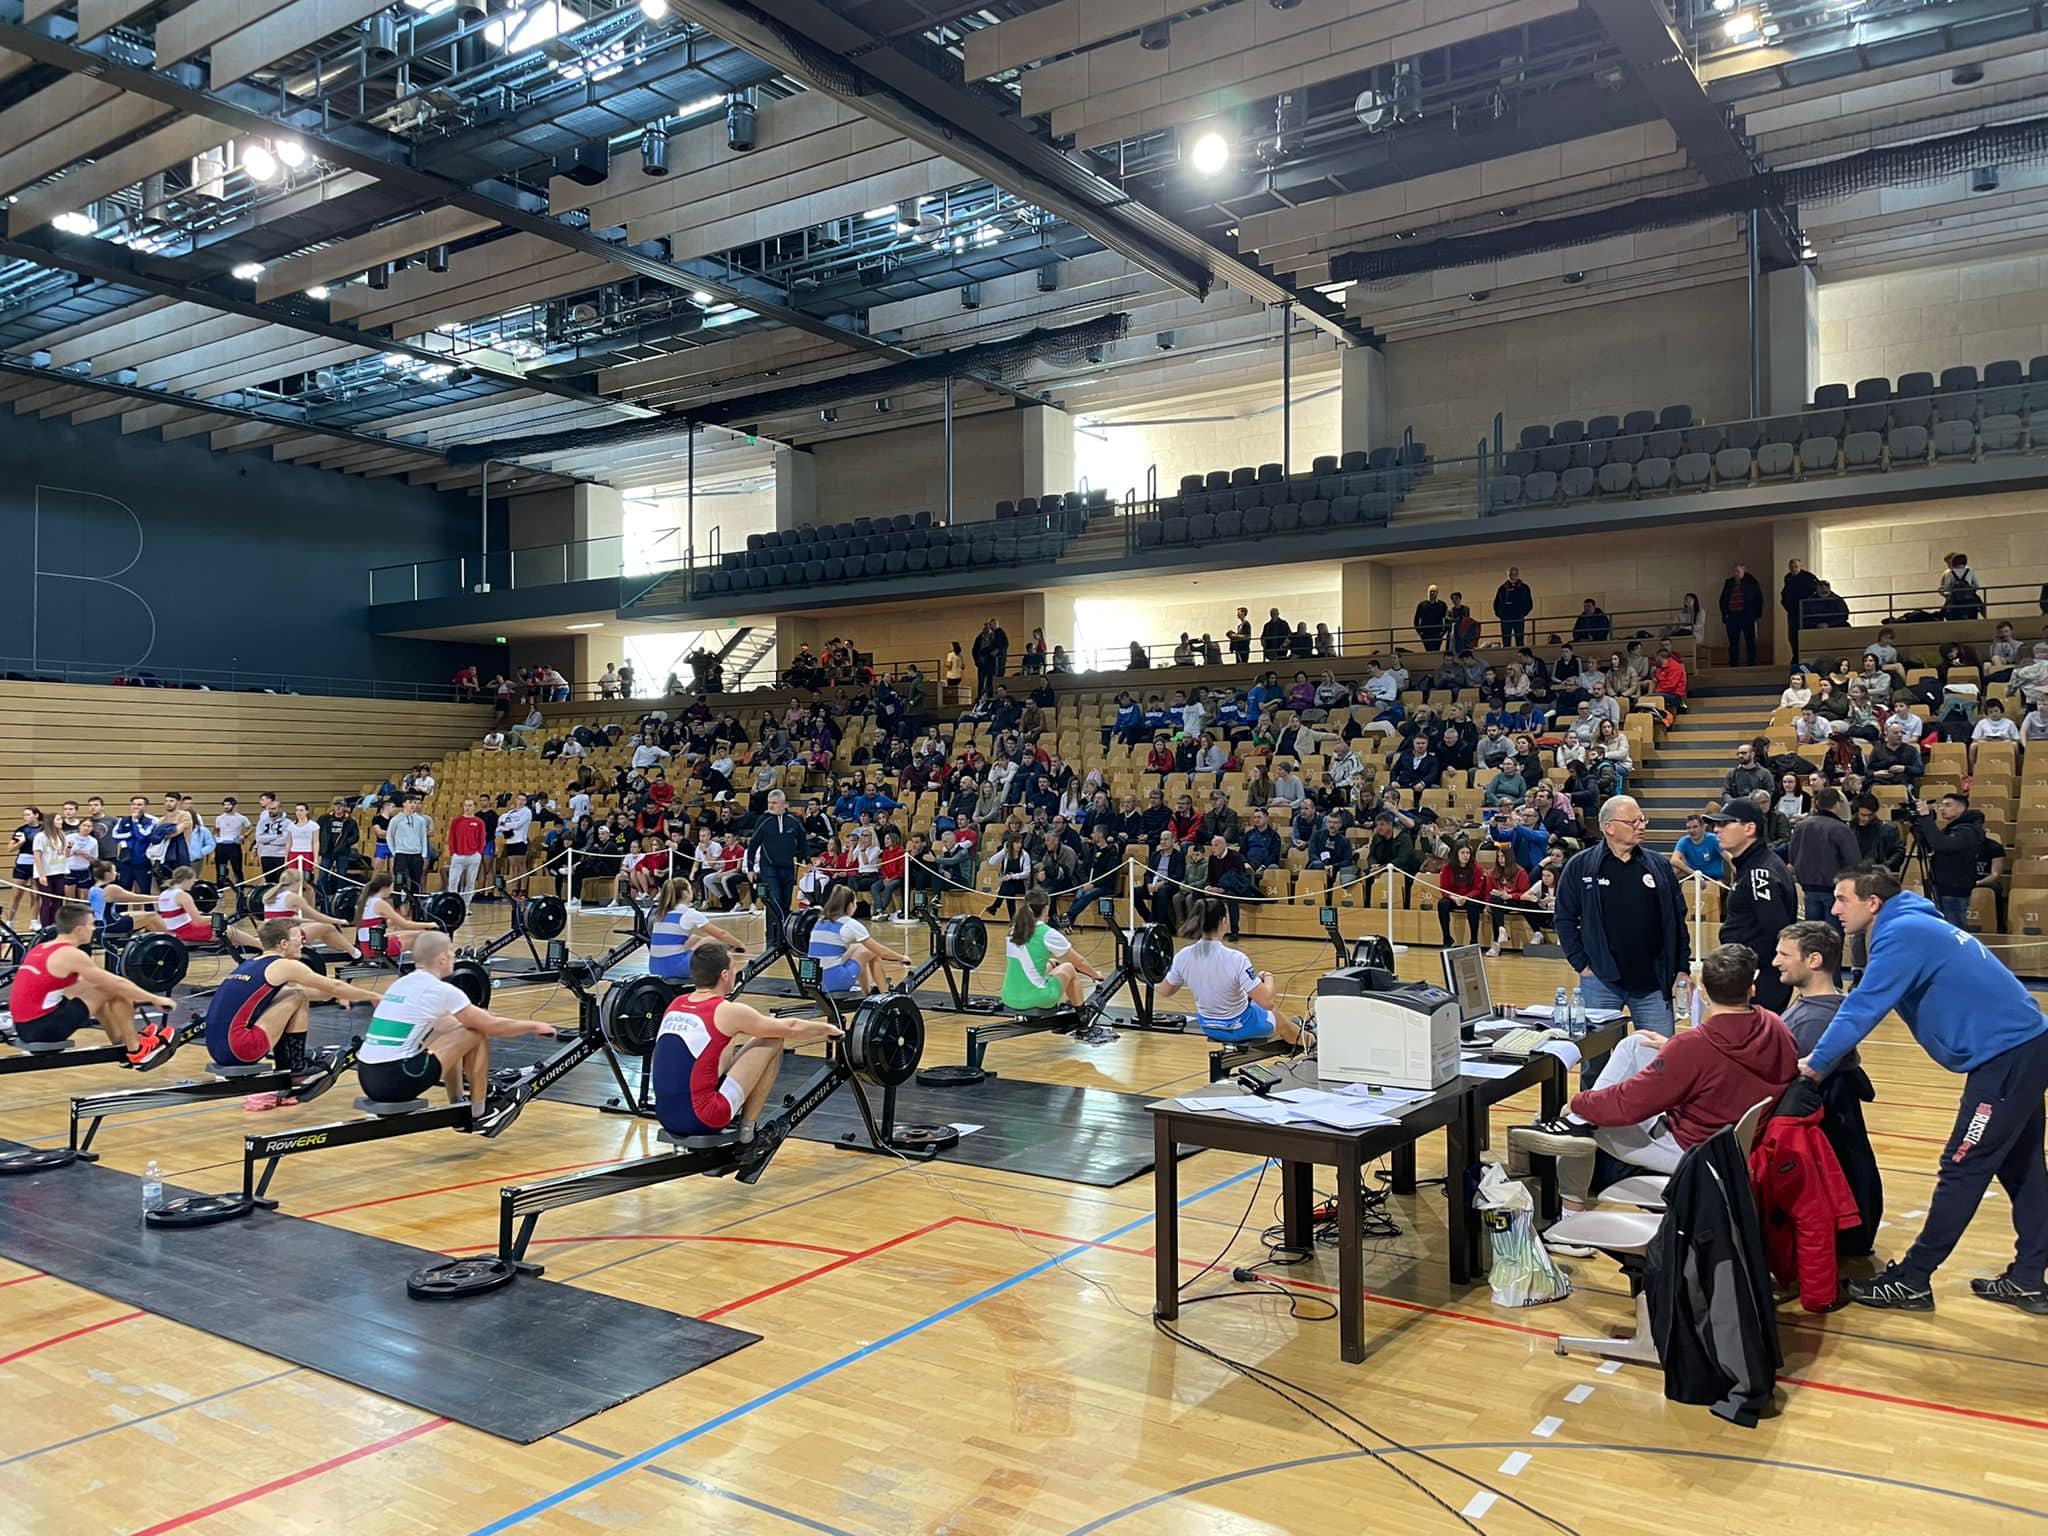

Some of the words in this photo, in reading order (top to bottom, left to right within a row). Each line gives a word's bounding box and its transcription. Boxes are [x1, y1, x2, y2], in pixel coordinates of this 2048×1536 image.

[33, 484, 156, 675] B
[1755, 868, 1771, 901] EA7
[539, 1050, 583, 1086] concept
[582, 1044, 590, 1054] 2
[790, 1081, 831, 1122] concept
[830, 1074, 838, 1085] 2
